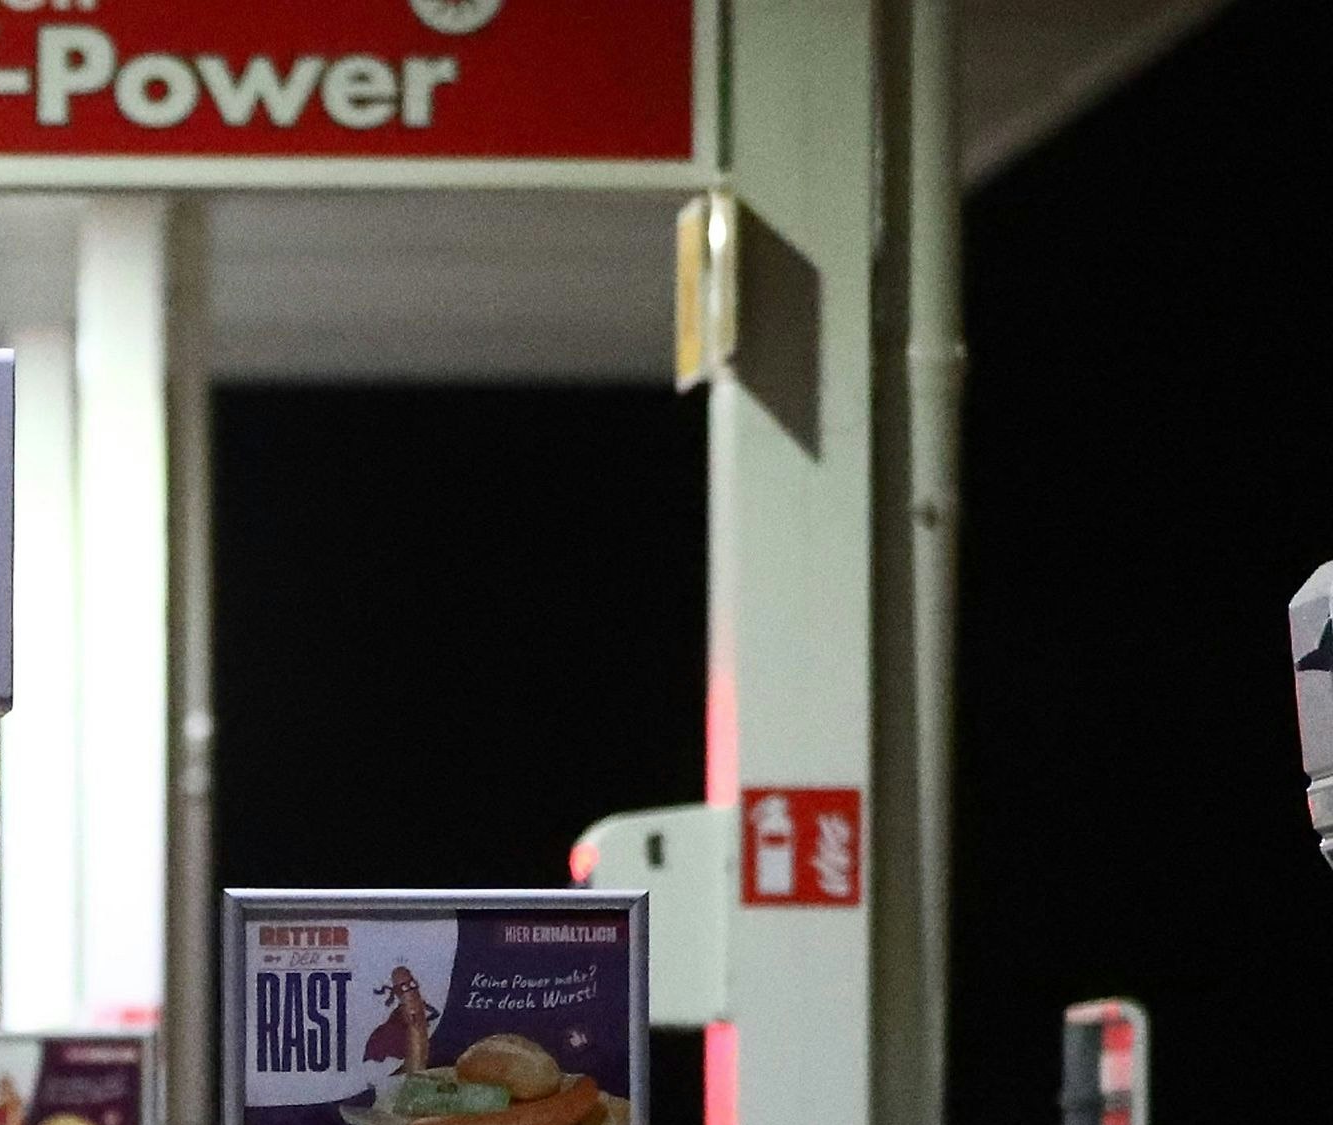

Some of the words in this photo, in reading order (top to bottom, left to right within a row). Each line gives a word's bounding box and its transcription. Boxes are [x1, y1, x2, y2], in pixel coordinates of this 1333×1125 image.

[505, 926, 532, 942] HIER
[471, 972, 509, 989] Keine
[512, 974, 551, 989] Power
[554, 965, 597, 986] mehr?
[464, 991, 493, 1009] Iss
[497, 993, 536, 1009] doch
[542, 981, 598, 1009] Wurst!
[256, 972, 352, 1072] RAST
